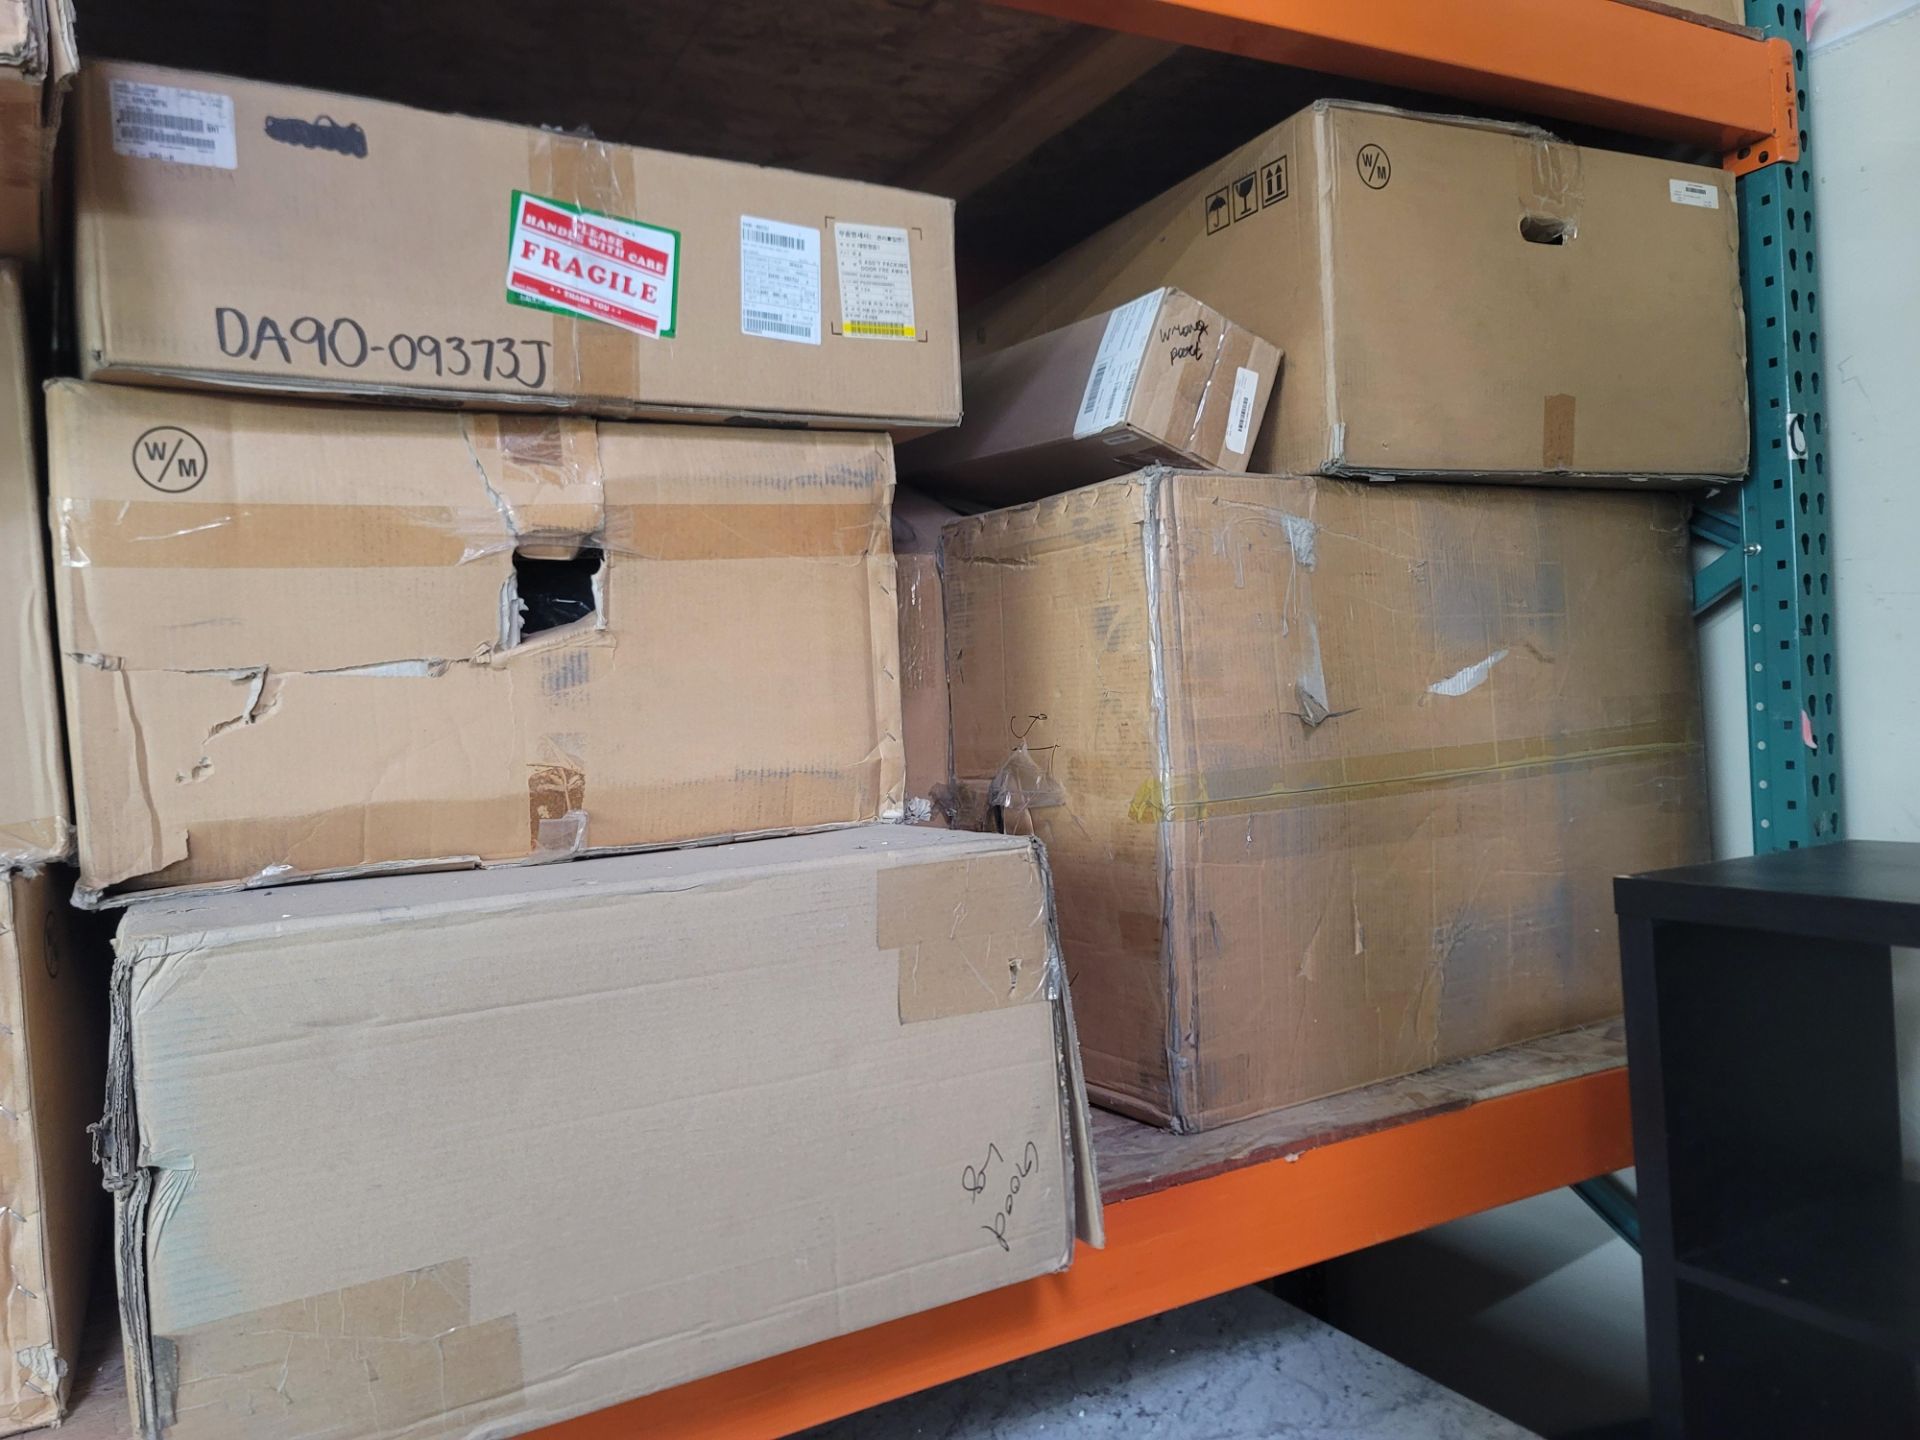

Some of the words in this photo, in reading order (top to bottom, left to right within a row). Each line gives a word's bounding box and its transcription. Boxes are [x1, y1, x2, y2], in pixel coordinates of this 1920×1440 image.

[1362, 152, 1386, 182] W/M
[525, 214, 585, 245] HANDLE
[588, 239, 625, 259] WITH
[627, 251, 664, 273] CARE
[574, 222, 625, 247] PLEASE
[520, 239, 659, 304] FRAGILE
[563, 290, 591, 305] THANK
[592, 300, 610, 312] YOU
[214, 307, 552, 389] DA90-09373J
[144, 438, 197, 482] W/M
[981, 1141, 1039, 1252] Good
